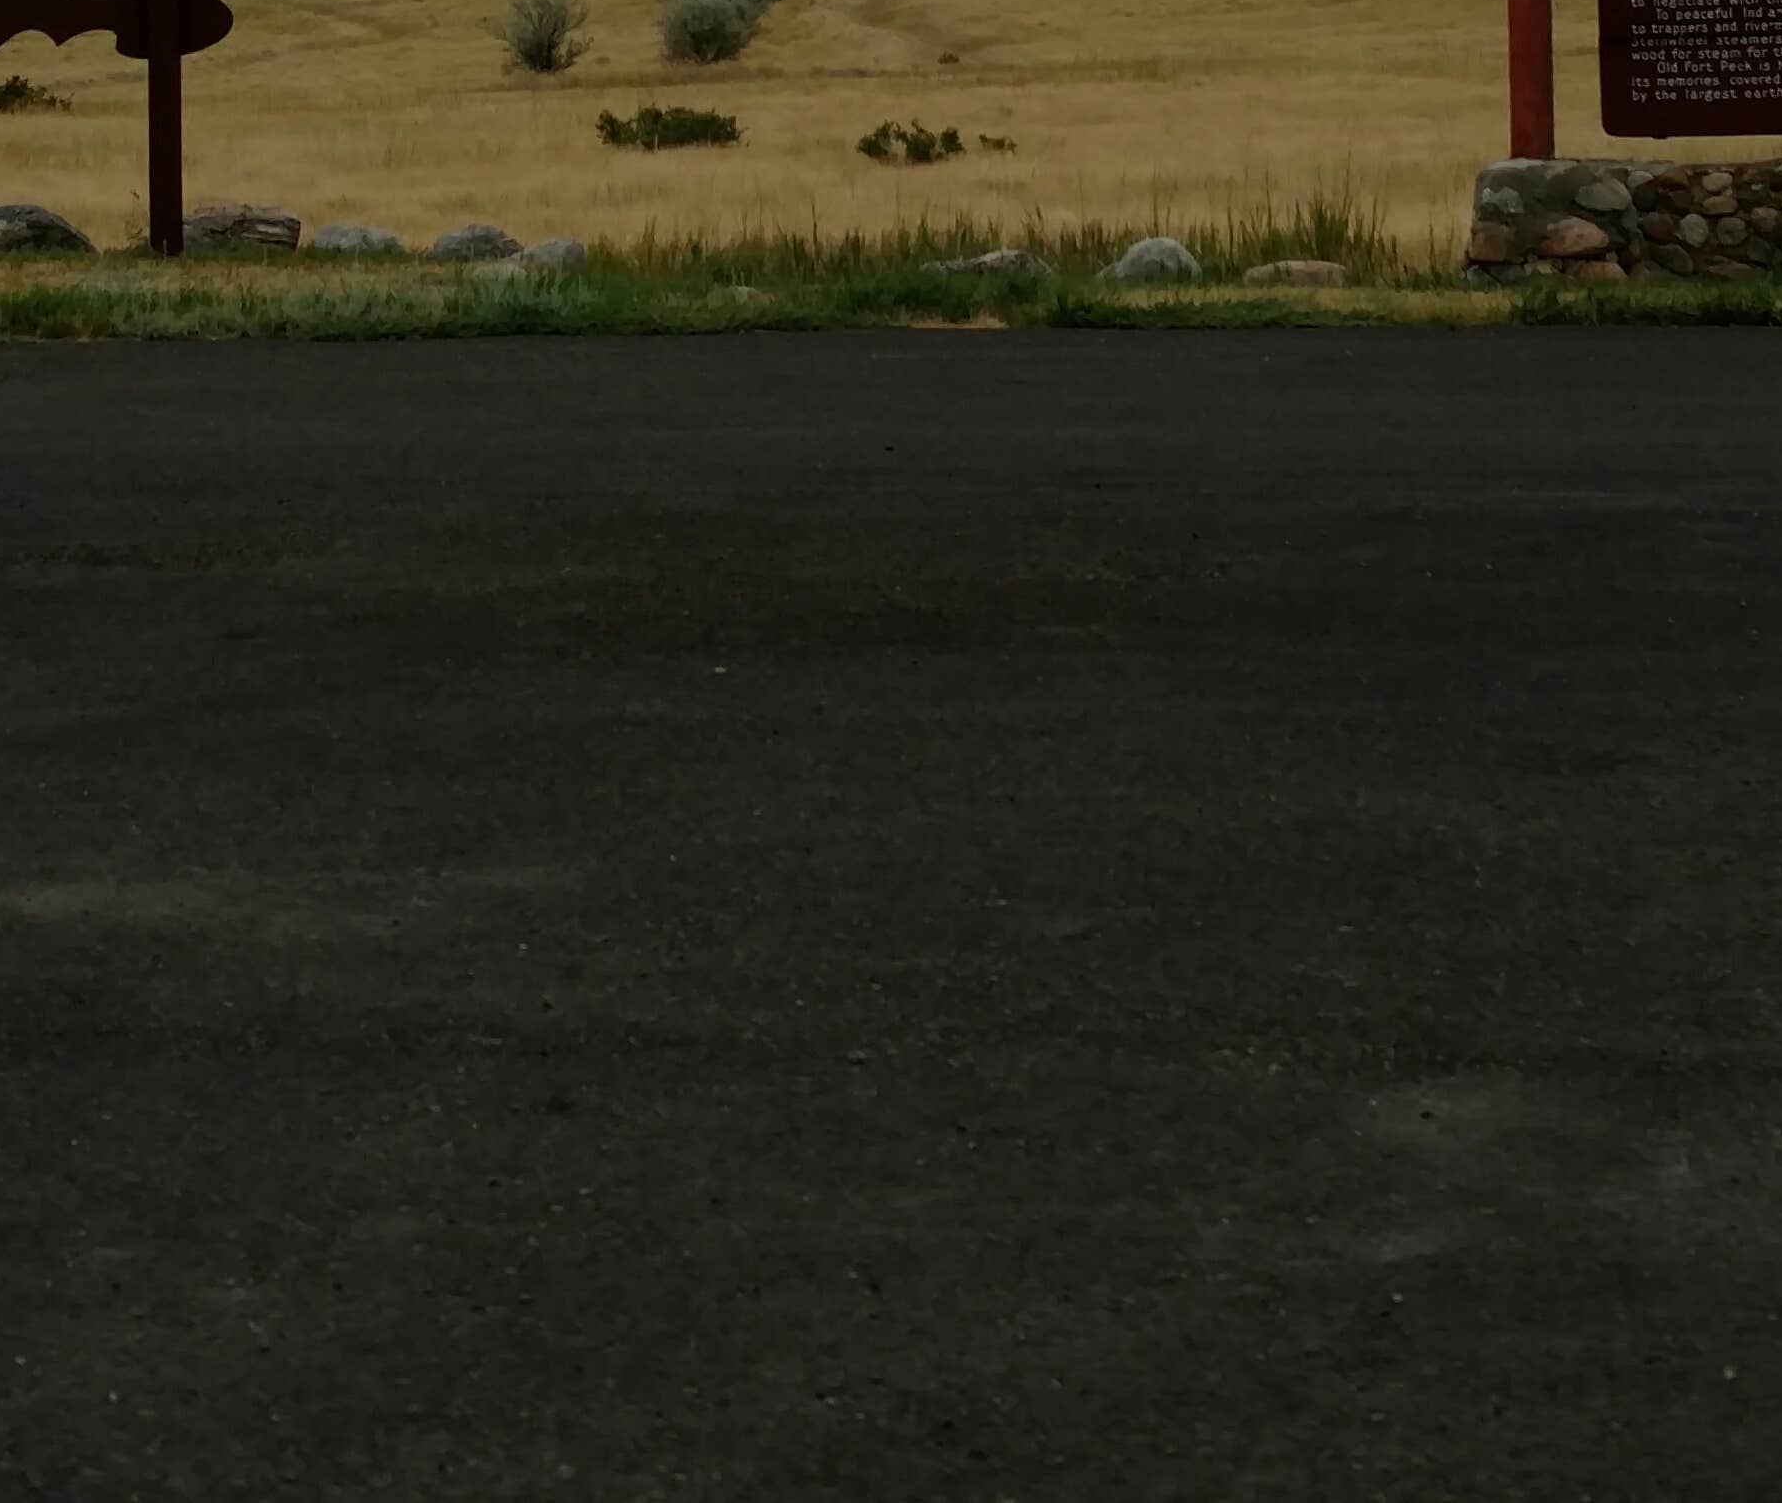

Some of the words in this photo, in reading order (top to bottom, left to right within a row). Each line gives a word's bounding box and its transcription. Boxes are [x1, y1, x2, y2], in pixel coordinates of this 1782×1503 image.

[1676, 7, 1733, 20] peaceful
[1632, 24, 1646, 34] to
[1652, 23, 1708, 35] trappers
[1714, 21, 1738, 32] and
[1716, 35, 1782, 45] steamers
[1632, 49, 1665, 61] wood
[1672, 48, 1691, 59] for
[1698, 48, 1741, 59] steam
[1748, 46, 1768, 58] for
[1657, 61, 1678, 74] Old
[1685, 61, 1714, 73] Fort
[1721, 60, 1752, 72] Peck
[1730, 73, 1780, 85] covered
[1632, 88, 1647, 103] by
[1655, 88, 1676, 100] the
[1685, 86, 1738, 102] largest
